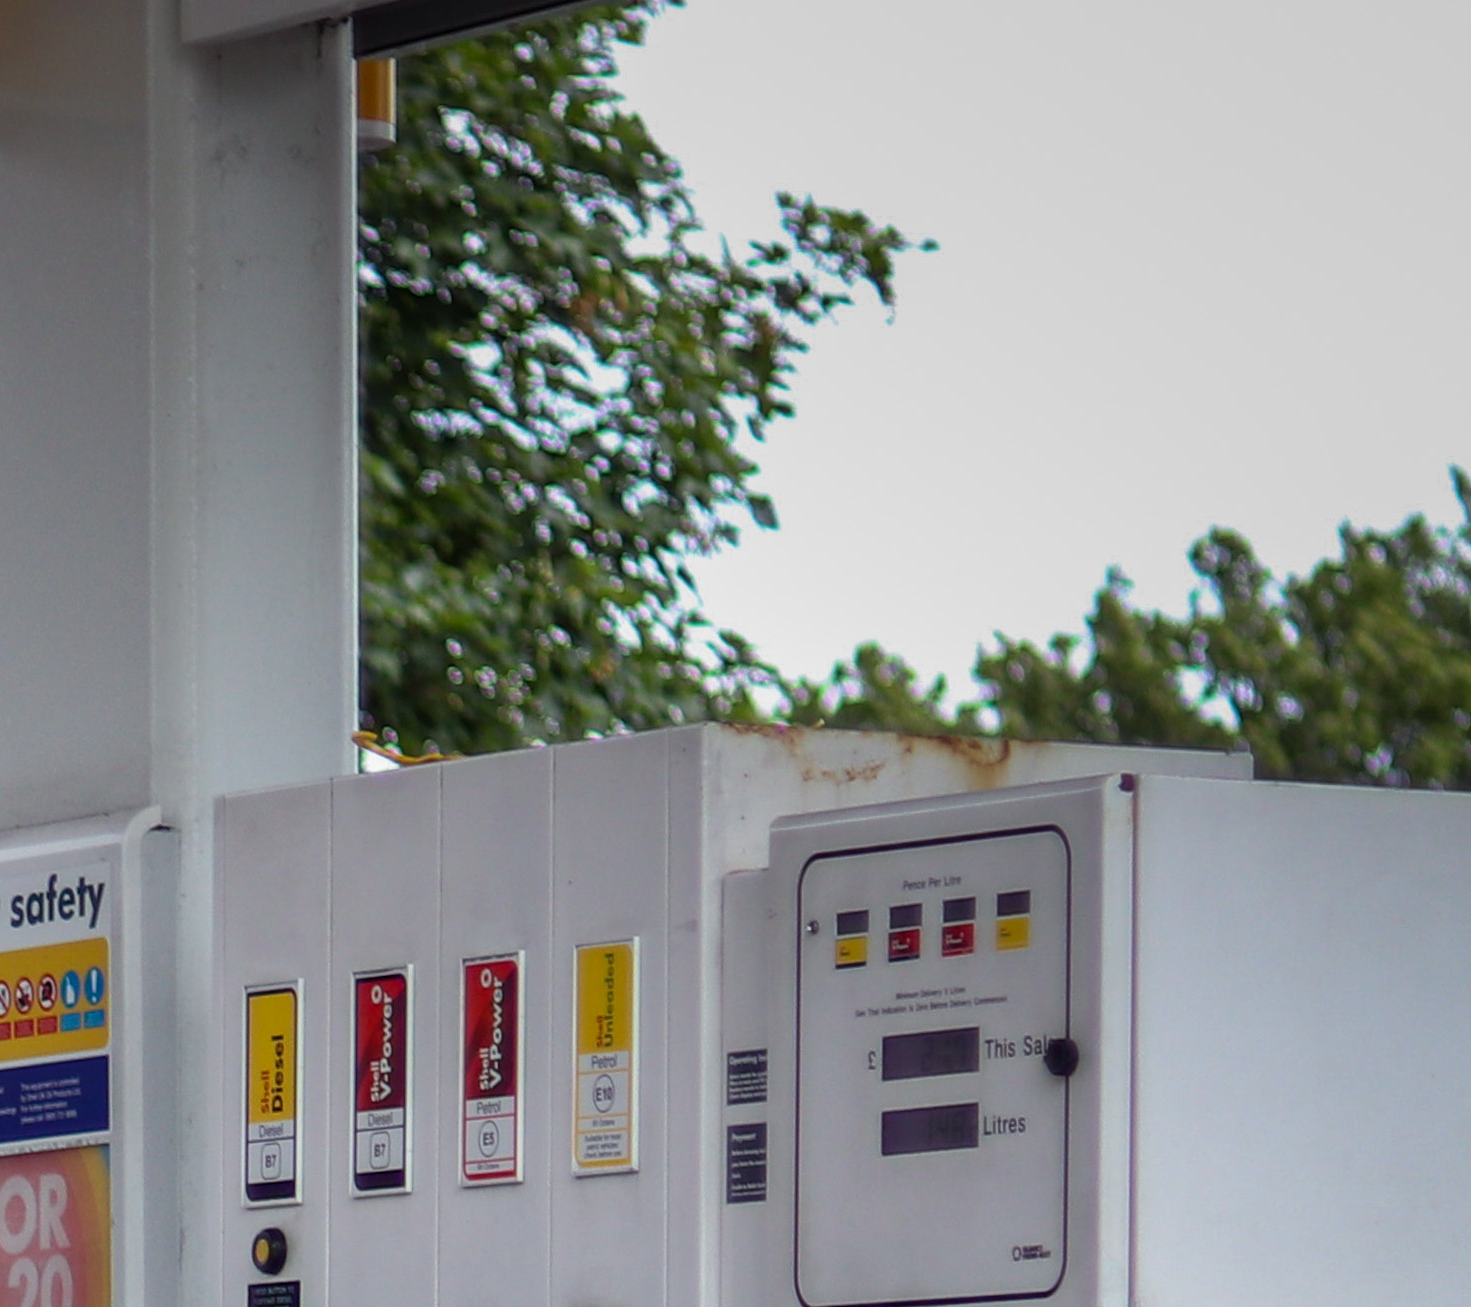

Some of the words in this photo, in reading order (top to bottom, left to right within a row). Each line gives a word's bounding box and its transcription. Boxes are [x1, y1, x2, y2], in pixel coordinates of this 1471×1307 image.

[902, 879, 926, 891] Pence
[928, 877, 941, 889] Per
[944, 875, 963, 887] Litre
[10, 873, 105, 929] safety
[604, 952, 615, 1048] Unleaded
[489, 976, 504, 1089] V-Power
[596, 1015, 604, 1049] Shell
[379, 991, 393, 1101] V-Power
[984, 1039, 1016, 1060] This
[1023, 1034, 1054, 1057] Sal
[271, 1034, 285, 1113] Diesel
[479, 1047, 489, 1091] Shell
[591, 1055, 618, 1070] Petrol
[261, 1070, 270, 1114] Shell
[370, 1061, 380, 1102] Shell
[596, 1086, 613, 1102] E10
[367, 1111, 393, 1127] Diesel
[476, 1100, 501, 1116] Petrol
[258, 1123, 284, 1138] Diesel
[983, 1115, 1026, 1136] Litres
[374, 1143, 386, 1158] B7
[483, 1132, 495, 1146] E5
[265, 1154, 277, 1169] B7
